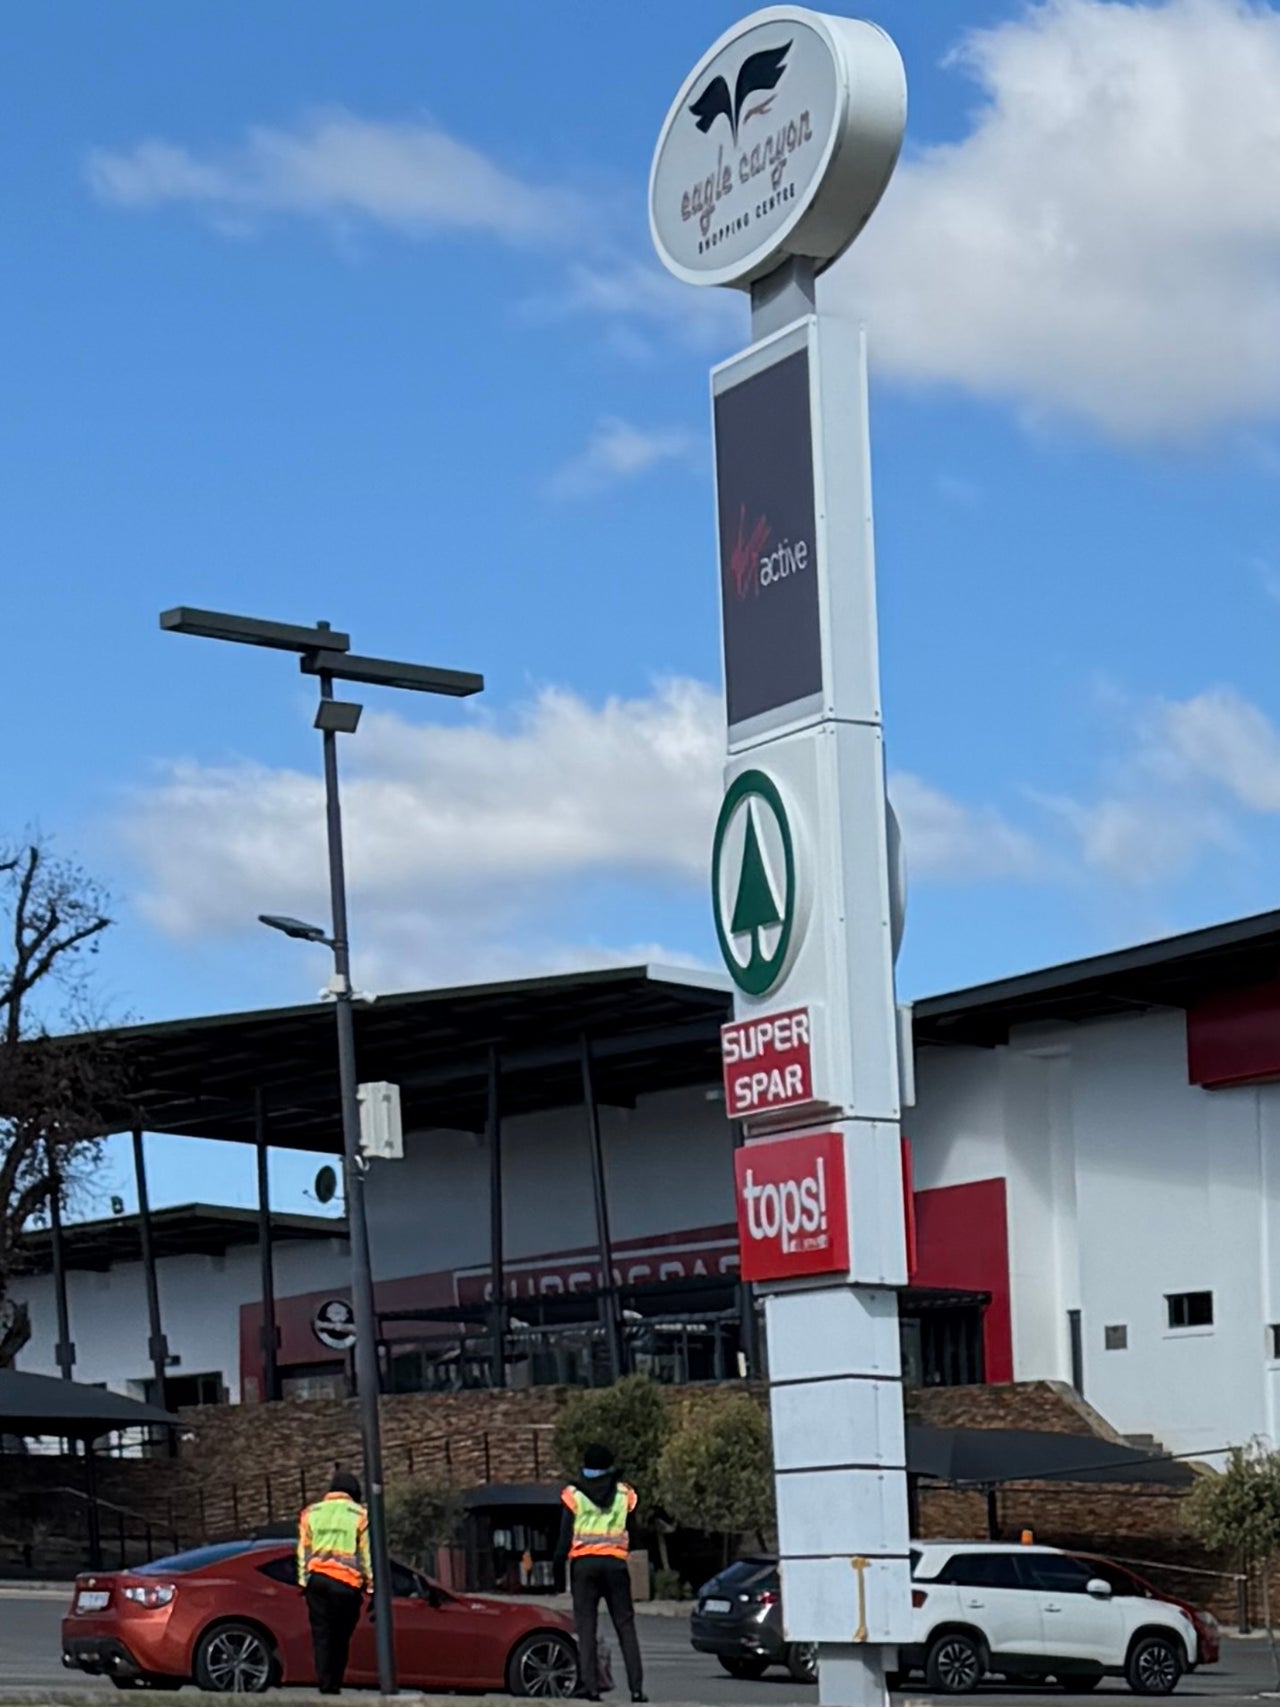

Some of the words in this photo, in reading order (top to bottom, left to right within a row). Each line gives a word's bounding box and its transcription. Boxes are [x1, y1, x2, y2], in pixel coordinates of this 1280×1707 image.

[681, 145, 733, 236] eagle
[739, 110, 812, 191] canyon
[760, 538, 808, 586] active
[722, 1013, 809, 1064] SUPER
[735, 1064, 803, 1109] SPAR
